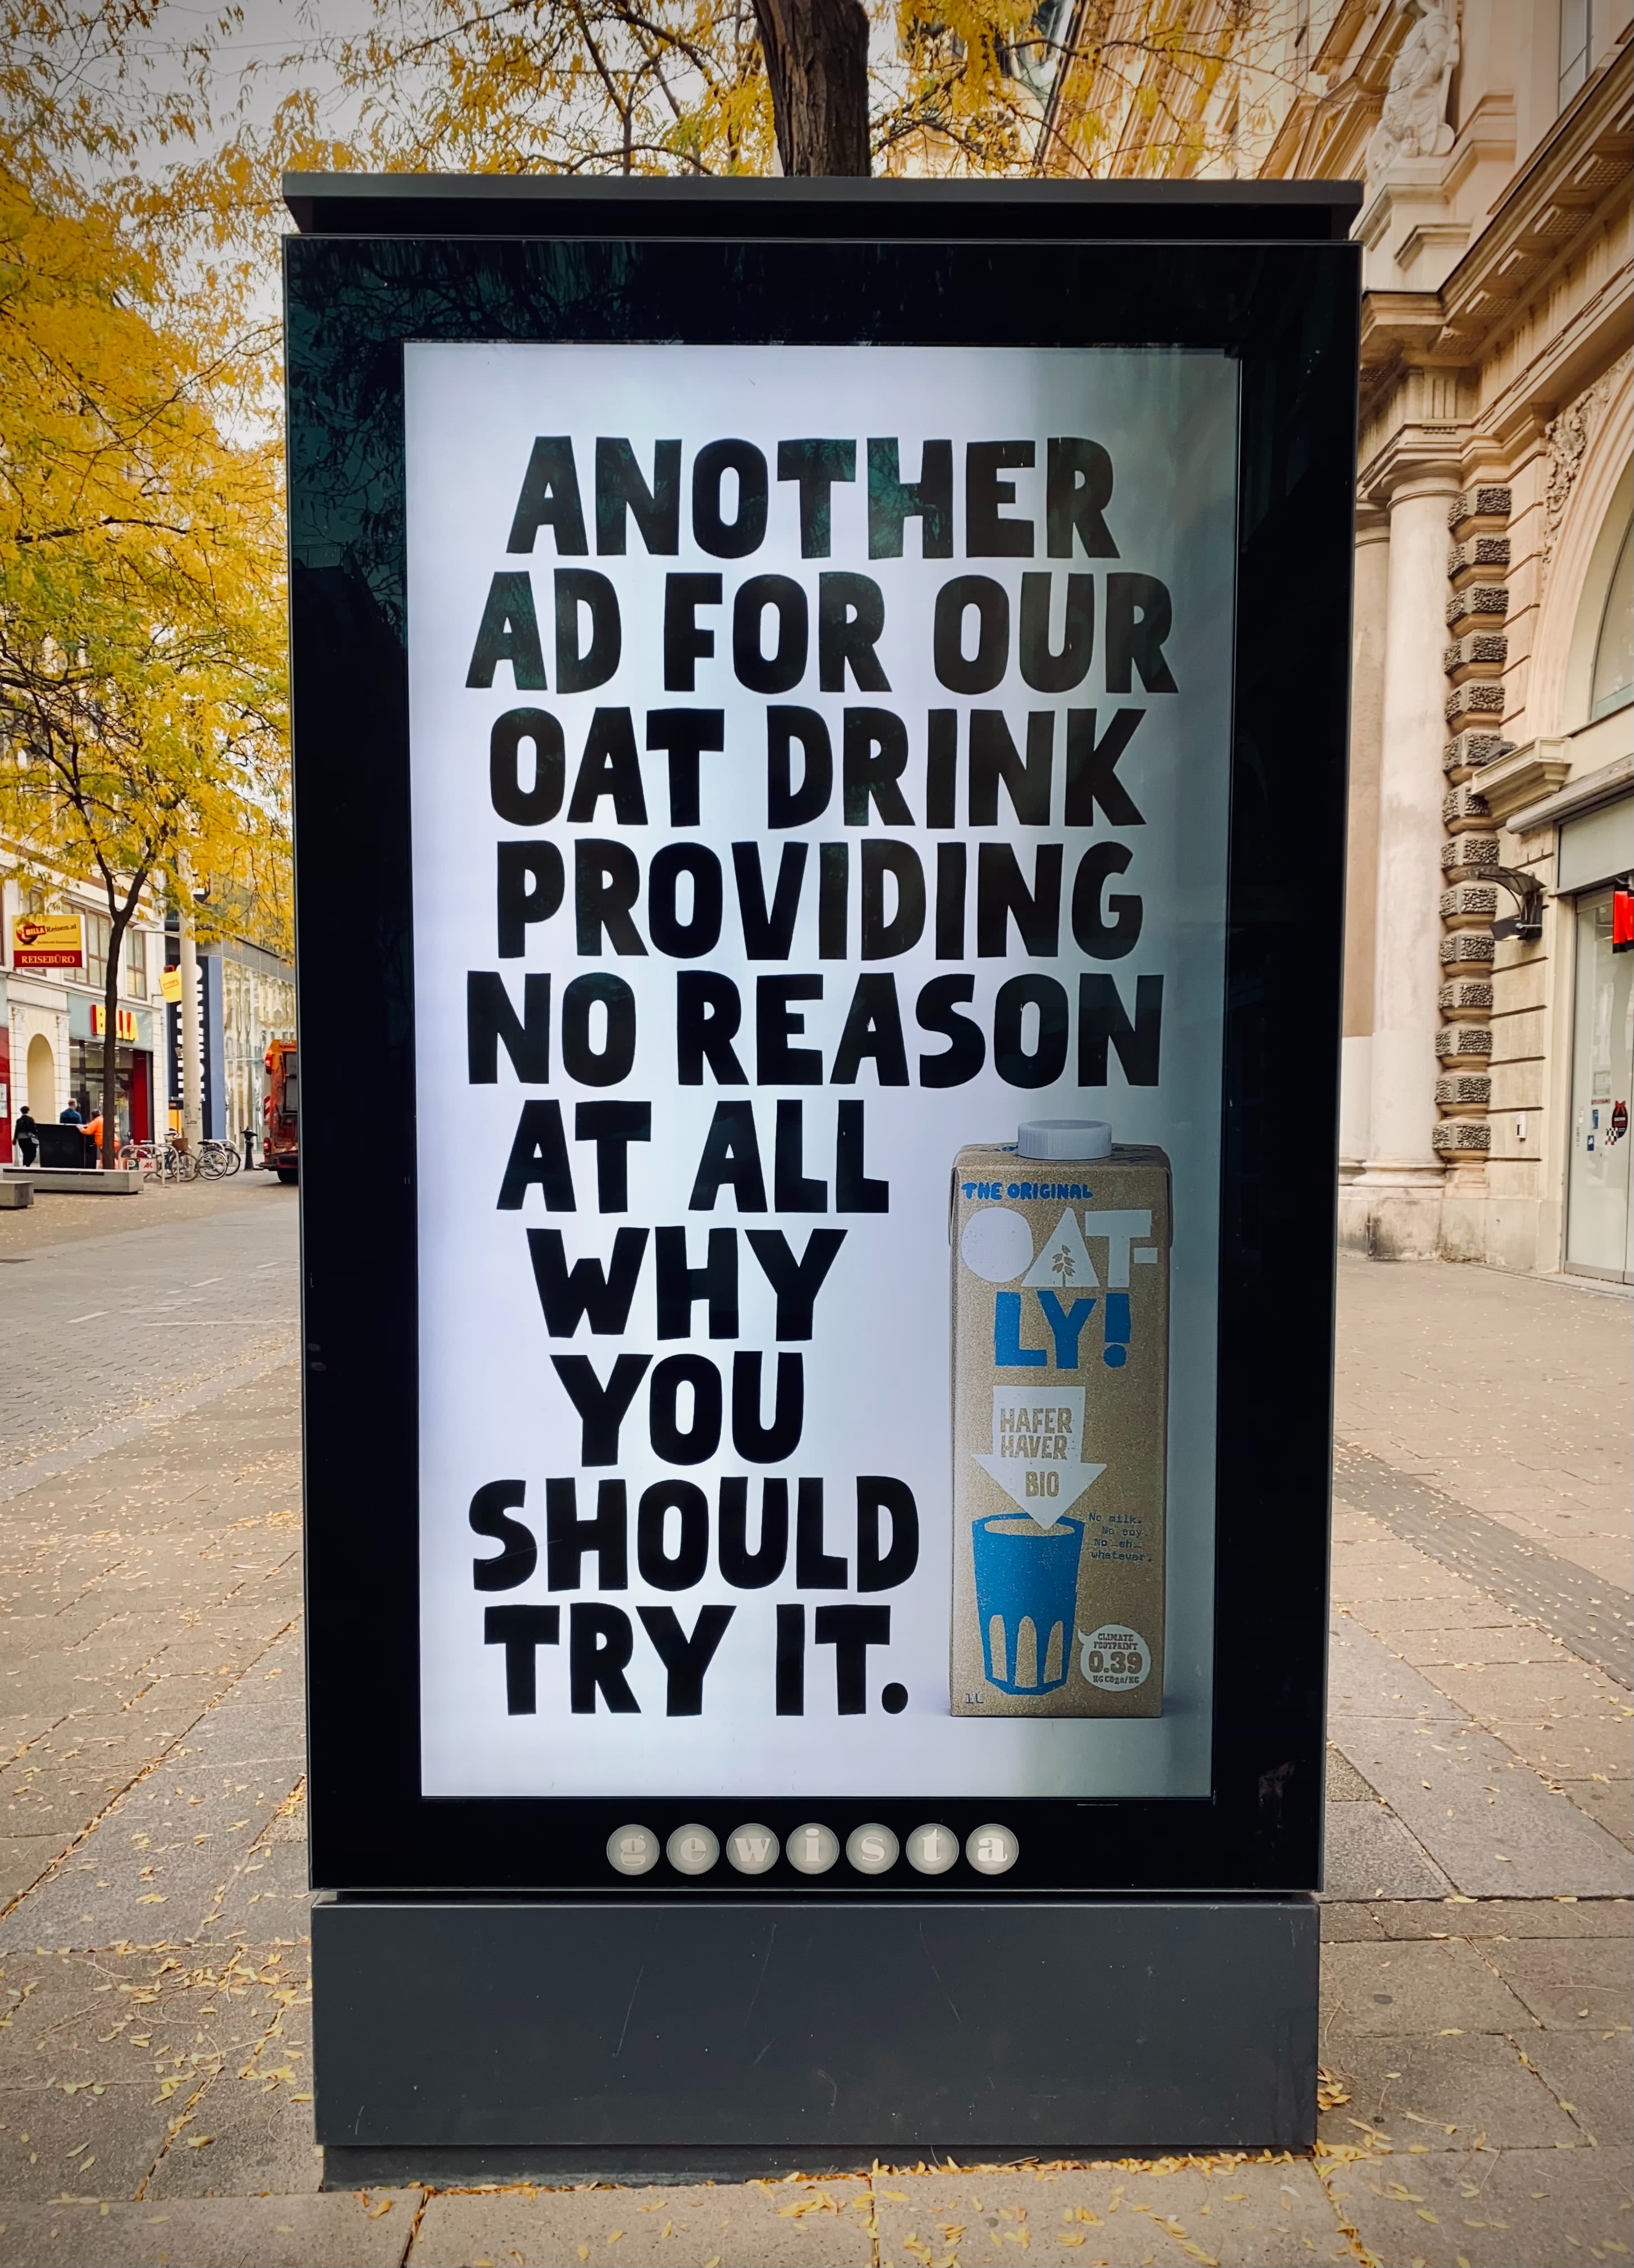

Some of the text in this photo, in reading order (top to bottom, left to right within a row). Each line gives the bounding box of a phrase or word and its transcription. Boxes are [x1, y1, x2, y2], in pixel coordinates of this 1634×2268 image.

[506, 436, 1121, 560] ANOTHER
[465, 568, 1179, 695] AD FOR OUR
[490, 705, 1147, 830] OAT DRINK
[497, 838, 1143, 961] PROVIDING
[25, 924, 76, 936] BILLA Reisen.at
[21, 954, 75, 964] REISEBÜRO
[92, 1004, 139, 1041] BLLA
[467, 970, 1164, 1089] NO REASON
[497, 1099, 889, 1214] AT ALL
[961, 1181, 1093, 1201] THE ORIGINAL
[526, 1226, 848, 1342] WHY
[994, 1290, 1131, 1369] LY!
[550, 1351, 804, 1468] YOU
[1000, 1407, 1072, 1433] HAFER
[1001, 1435, 1067, 1460] HAVER
[1025, 1471, 1059, 1497] BIO
[1089, 1512, 1142, 1524] No milk.
[469, 1475, 919, 1593] SHOULD
[1095, 1538, 1107, 1546] No
[1102, 1526, 1148, 1538] No soy.
[1091, 1550, 1152, 1563] whatever.
[1094, 1641, 1138, 1650] FOOTPRINT
[1098, 1633, 1134, 1642] CLIMATE
[485, 1602, 908, 1717] TRY IT.
[1089, 1650, 1143, 1674] 0.39
[966, 1693, 984, 1704] 1L
[620, 1828, 1008, 1866] gewista
